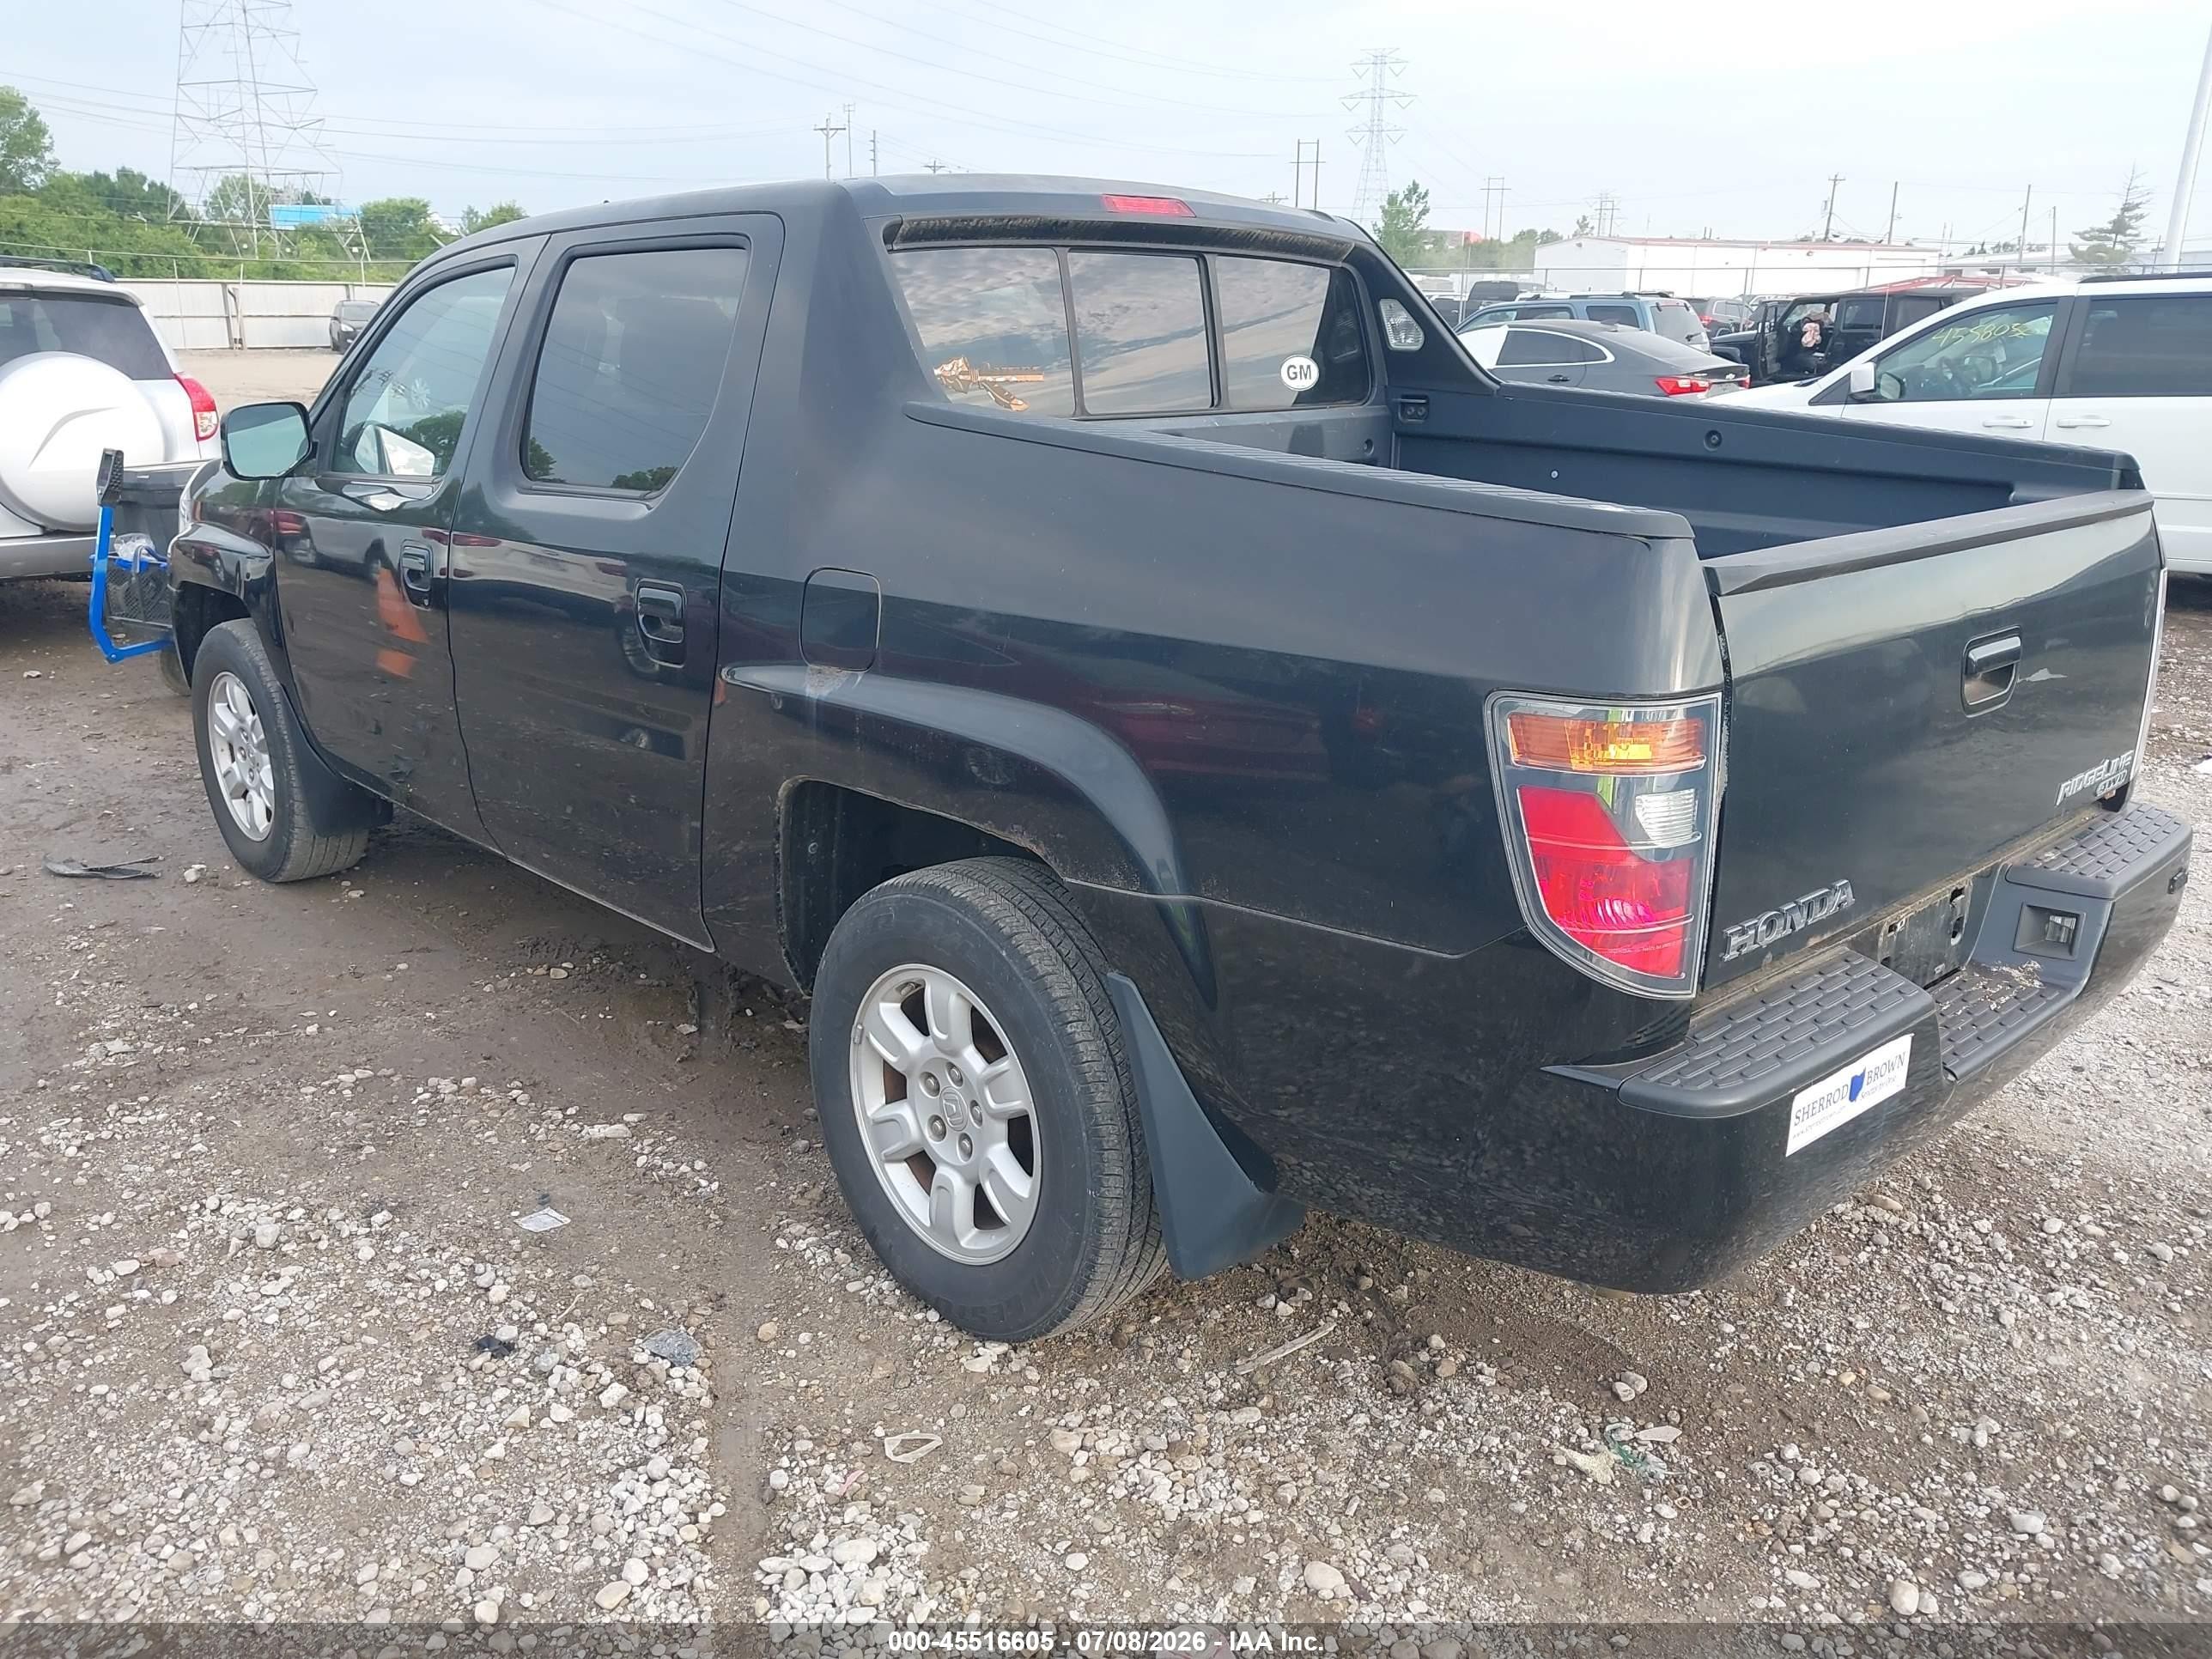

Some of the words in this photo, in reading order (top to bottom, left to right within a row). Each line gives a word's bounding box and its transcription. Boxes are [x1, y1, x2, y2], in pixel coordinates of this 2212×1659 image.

[1287, 364, 1311, 380] GM
[2055, 750, 2134, 806] RIDGELINE
[1720, 879, 1855, 962] HONDA
[1794, 1085, 1849, 1127] SHERROD
[1866, 1051, 1906, 1086] BROWN
